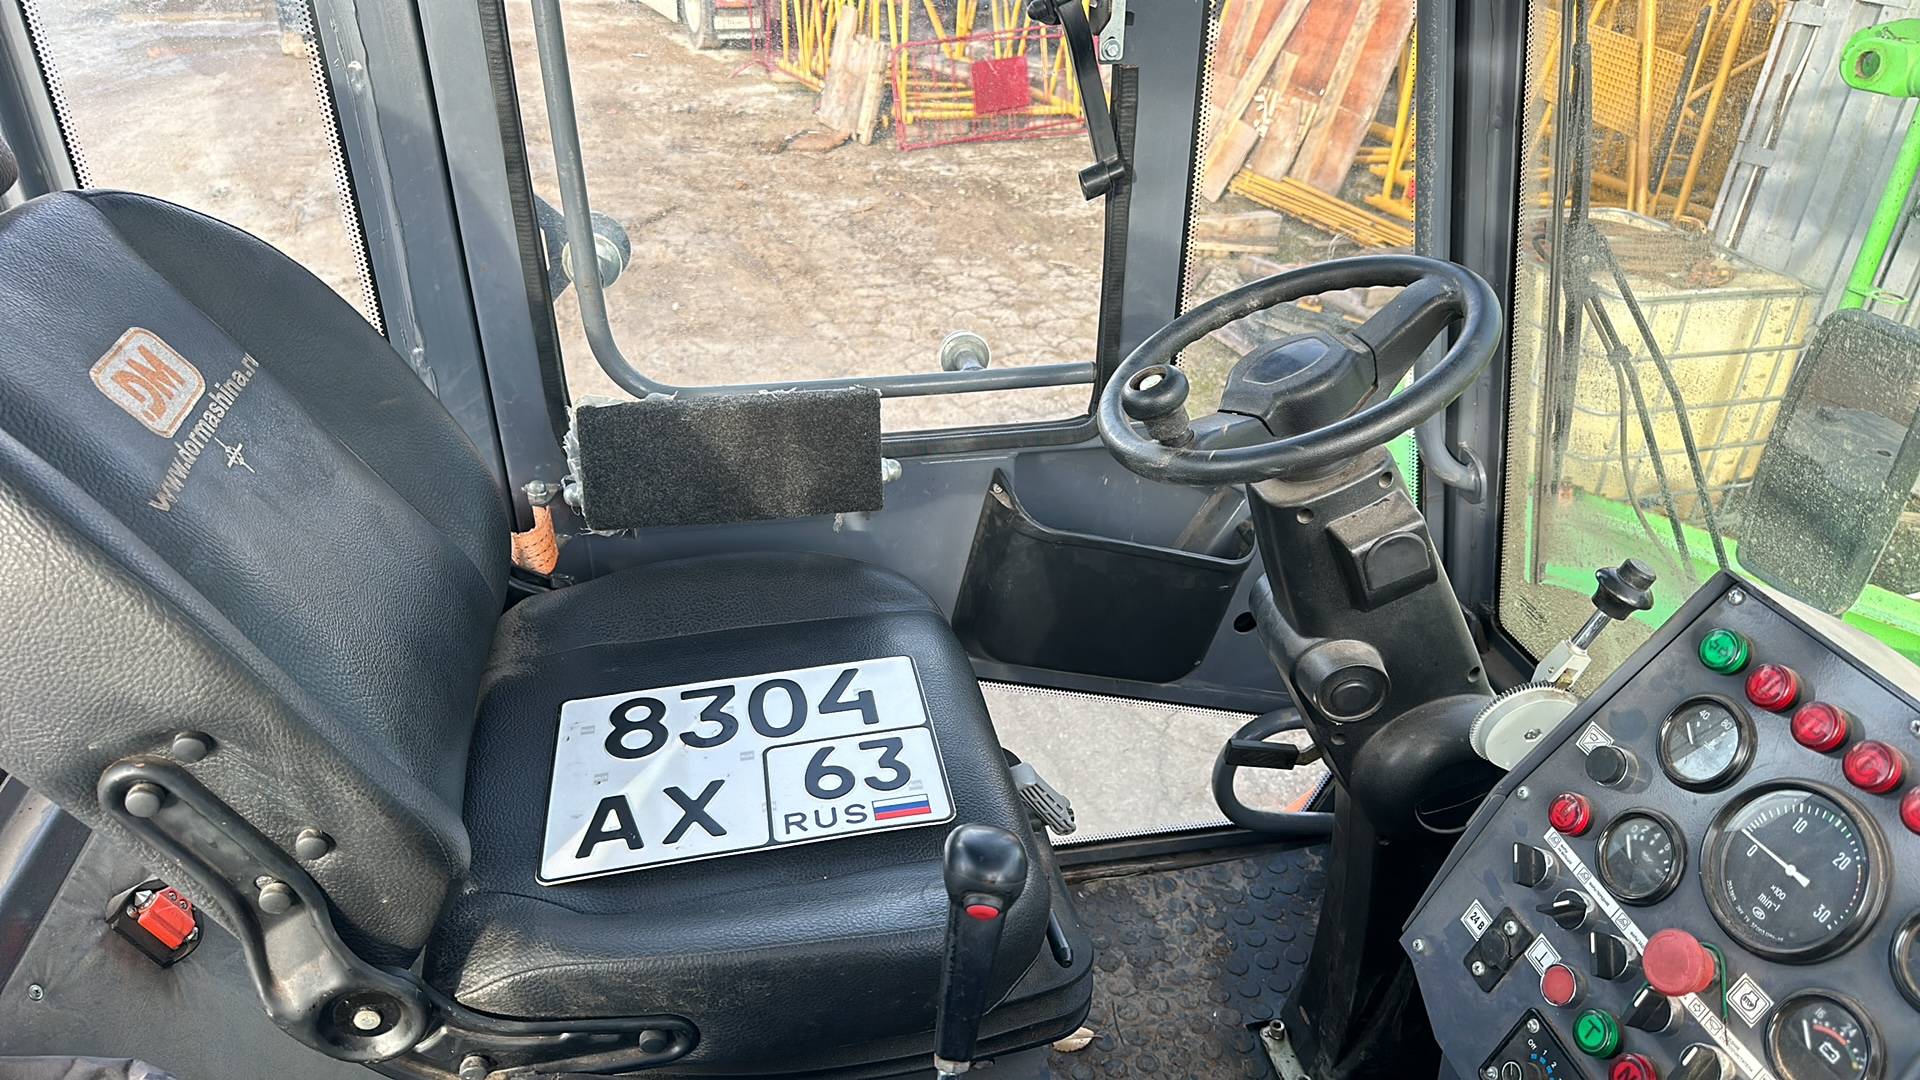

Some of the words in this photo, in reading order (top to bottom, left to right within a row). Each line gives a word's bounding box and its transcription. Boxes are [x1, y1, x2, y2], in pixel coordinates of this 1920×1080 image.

[604, 667, 880, 760] 8304
[1699, 709, 1711, 720] 40
[1720, 718, 1733, 730] 80
[803, 736, 912, 800] 63
[783, 803, 869, 836] RUS
[1792, 817, 1808, 834] 10
[1630, 824, 1639, 833] 0
[1640, 824, 1650, 834] 2
[1654, 832, 1662, 840] 4
[1746, 844, 1758, 857] 0
[1832, 852, 1851, 870] 20
[1469, 911, 1480, 925] 24
[1812, 903, 1831, 923] 30
[1742, 995, 1755, 1008] STOP
[1550, 1061, 1557, 1069] 2
